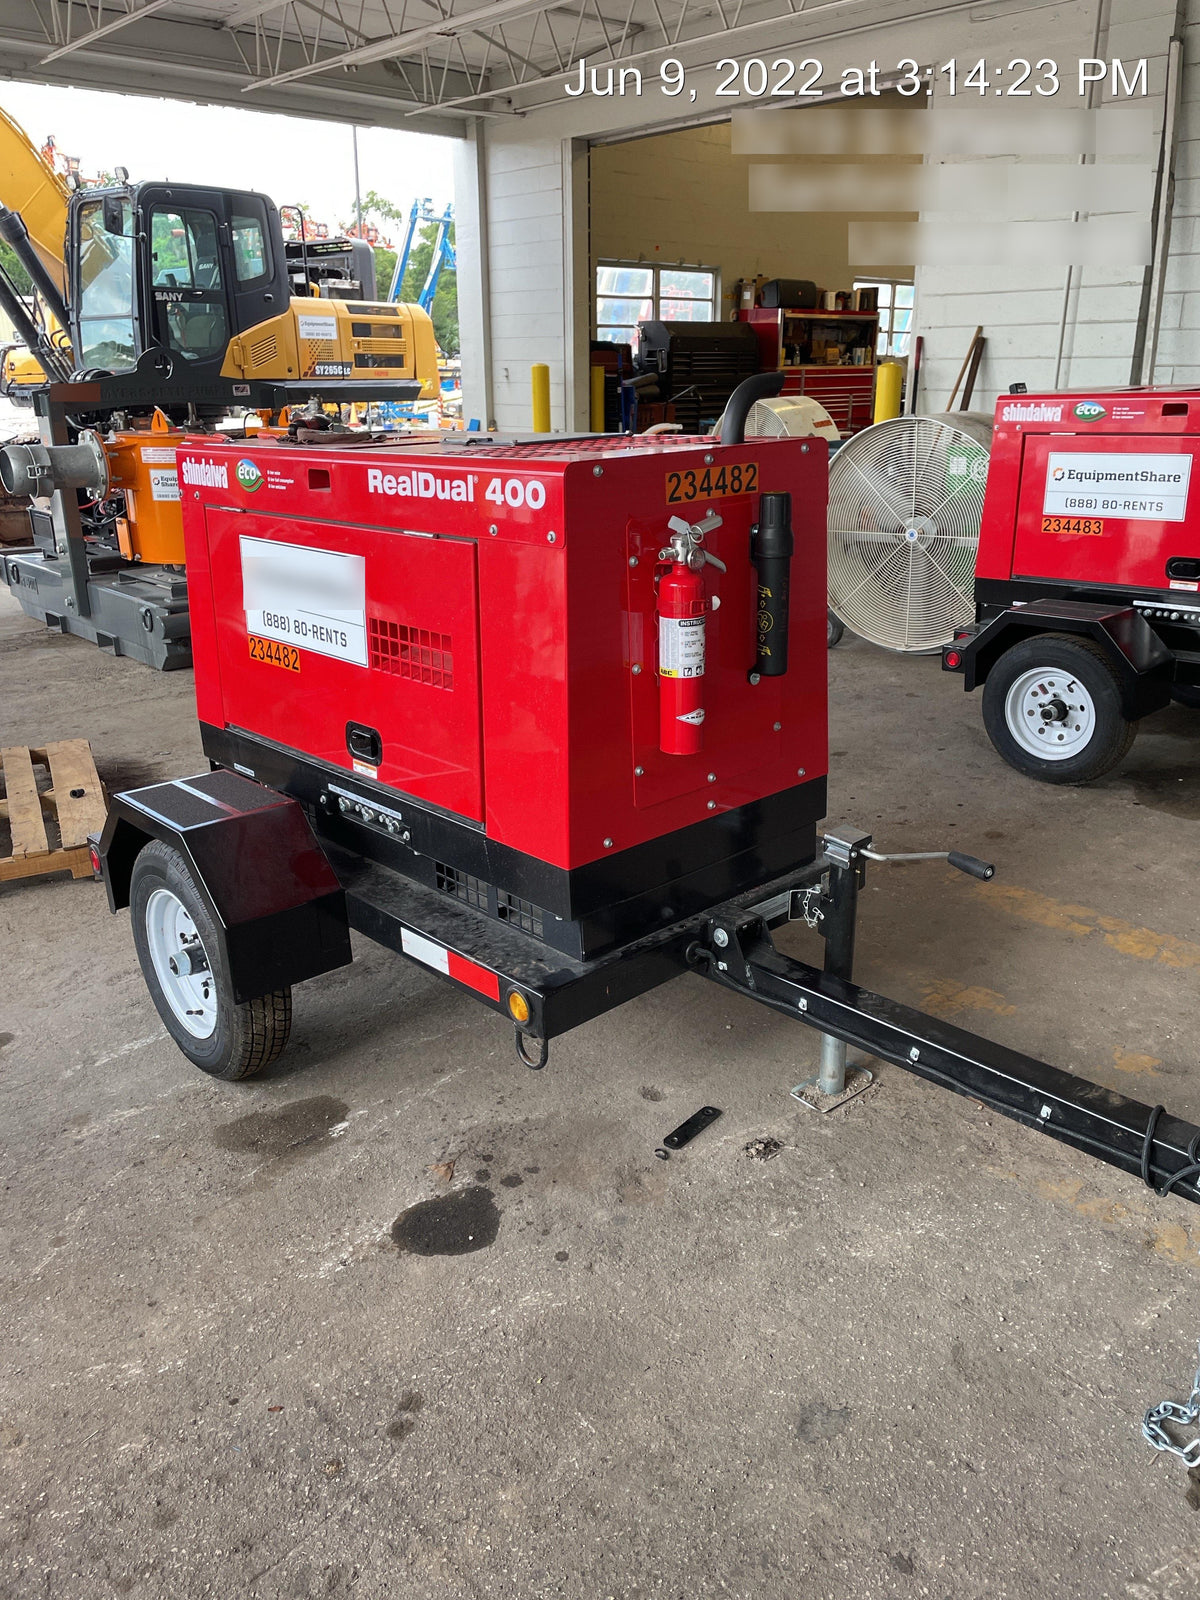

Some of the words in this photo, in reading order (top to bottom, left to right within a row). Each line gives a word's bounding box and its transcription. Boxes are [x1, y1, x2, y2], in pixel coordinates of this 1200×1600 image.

[198, 262, 213, 270] SANY
[154, 291, 183, 302] SANY
[315, 365, 343, 376] SY265C
[1002, 403, 1062, 422] shindaiwa
[1075, 404, 1100, 415] eco
[182, 457, 228, 489] shindaiwa
[238, 465, 257, 480] eco
[1067, 469, 1181, 483] EquipmentShare
[668, 463, 757, 503] 234482
[485, 477, 546, 510] 400
[1064, 497, 1098, 510] (888)
[1102, 499, 1164, 512] 80-RENTS
[1042, 518, 1102, 535] 234483
[262, 610, 290, 633] (888)
[293, 619, 347, 648] 80-RENTS
[249, 637, 300, 671] 234482
